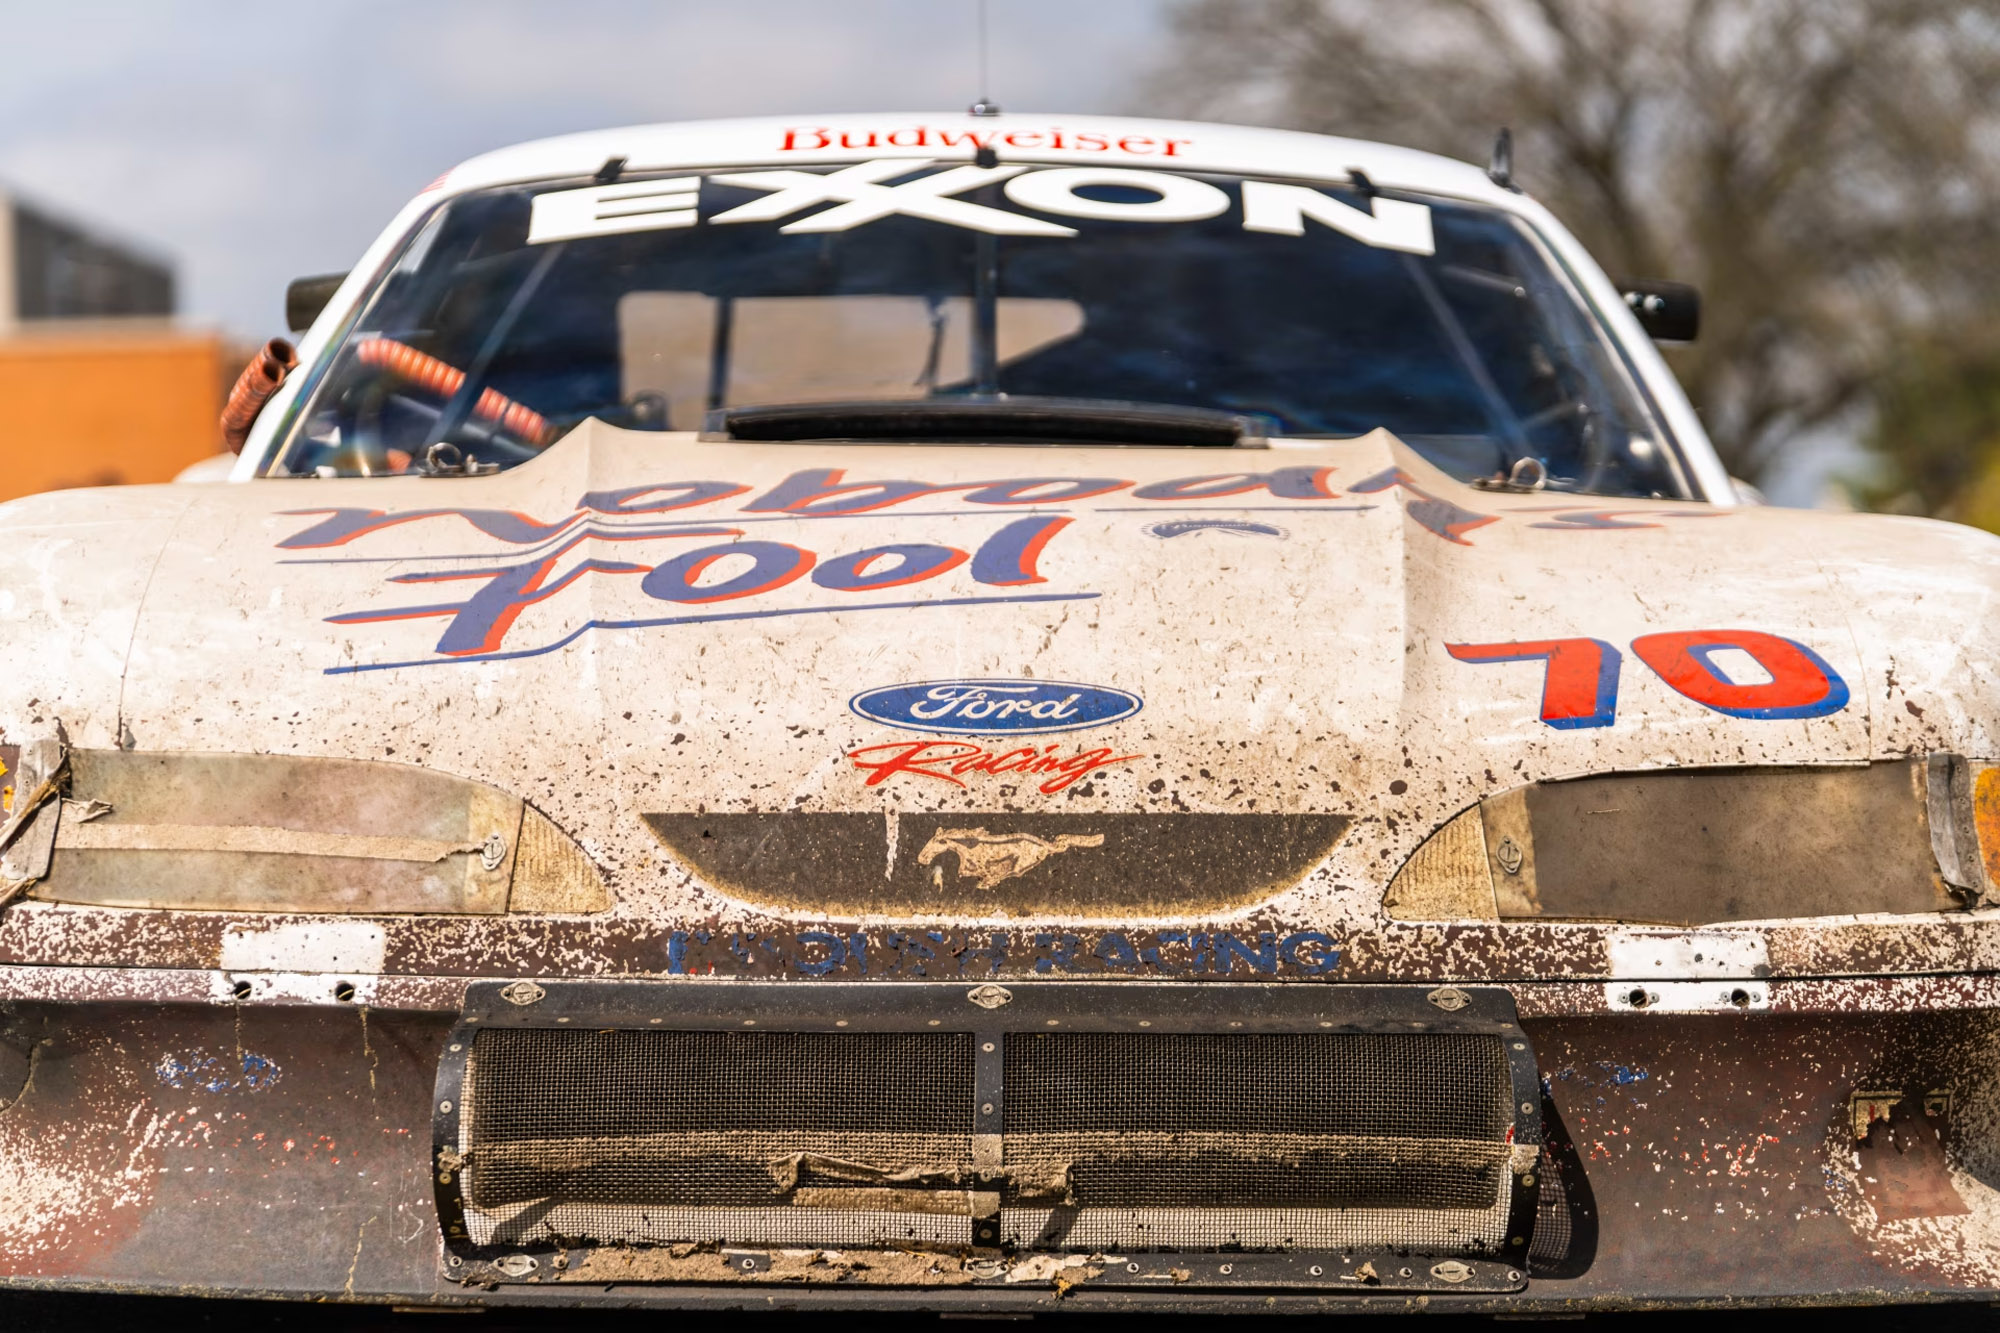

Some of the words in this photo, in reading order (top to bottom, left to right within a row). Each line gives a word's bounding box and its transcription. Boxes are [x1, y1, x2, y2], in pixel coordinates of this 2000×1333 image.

[777, 125, 1193, 157] Budweiser
[527, 158, 1436, 256] EXXON
[909, 684, 1082, 720] Ford
[1445, 630, 1850, 730] 70
[848, 740, 1145, 794] Racing
[1035, 931, 1341, 976] RACING
